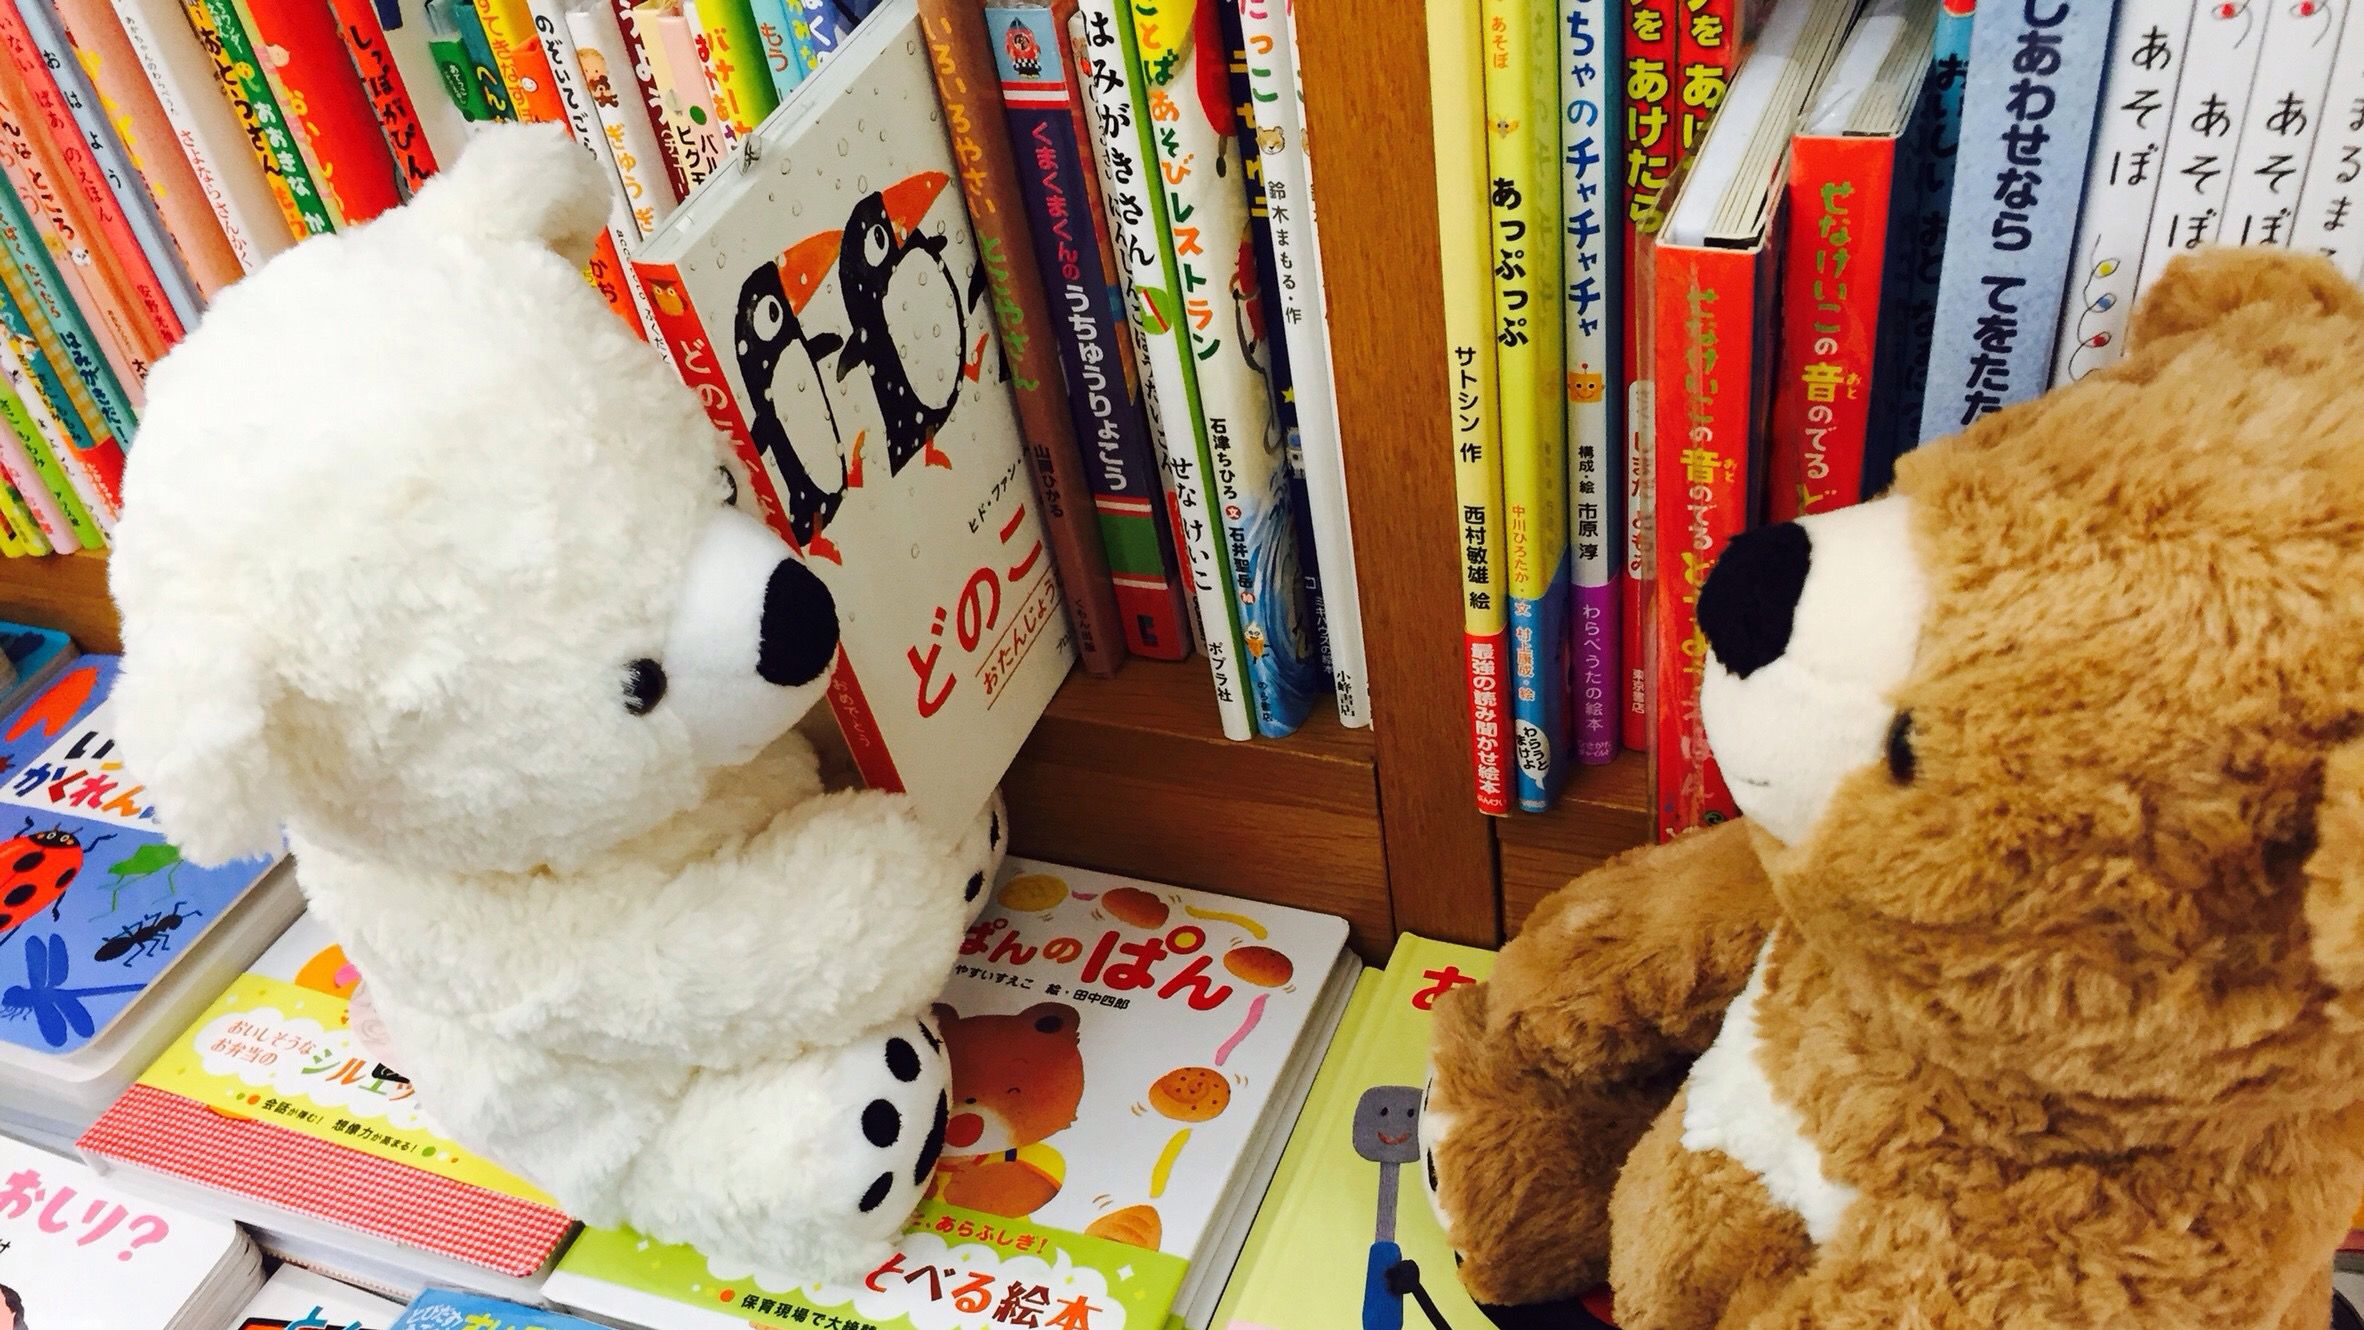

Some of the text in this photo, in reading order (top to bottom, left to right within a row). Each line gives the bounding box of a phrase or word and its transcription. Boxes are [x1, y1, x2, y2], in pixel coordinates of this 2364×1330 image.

[350, 26, 431, 180] しっぽがぴん
[1491, 16, 1509, 70] あそぼ
[2110, 24, 2172, 186] あそぼ
[42, 49, 120, 189] おはよう
[1083, 10, 1156, 267] はみがきさん
[1566, 0, 1601, 337] ちゃのチャチャチャ
[1990, 0, 2069, 251] しあわせなら
[2167, 92, 2232, 249] あそぼ
[2240, 91, 2308, 246] あそぼ
[1268, 180, 1302, 325] 鈴木まもる・作
[1492, 177, 1529, 347] あっぷっぷ
[1065, 284, 1128, 492] うちゅうりょこう
[1209, 417, 1238, 500] 石津ちひろ
[1172, 456, 1213, 592] せなけいこ
[1454, 346, 1491, 610] サトシン 作 西村敏雄 絵
[1577, 445, 1595, 495] 構成・絵
[983, 570, 1062, 697] おたんじょう
[1208, 641, 1234, 703] ポプラ社
[1582, 604, 1602, 731] わらべうたの絵本
[1471, 643, 1501, 794] 最強の読み聞かせ絵本
[210, 1038, 278, 1066] お弁当の
[227, 1019, 318, 1055] おいしそうな
[301, 1048, 417, 1102] シルエッ
[865, 1251, 1104, 1330] とべる絵本
